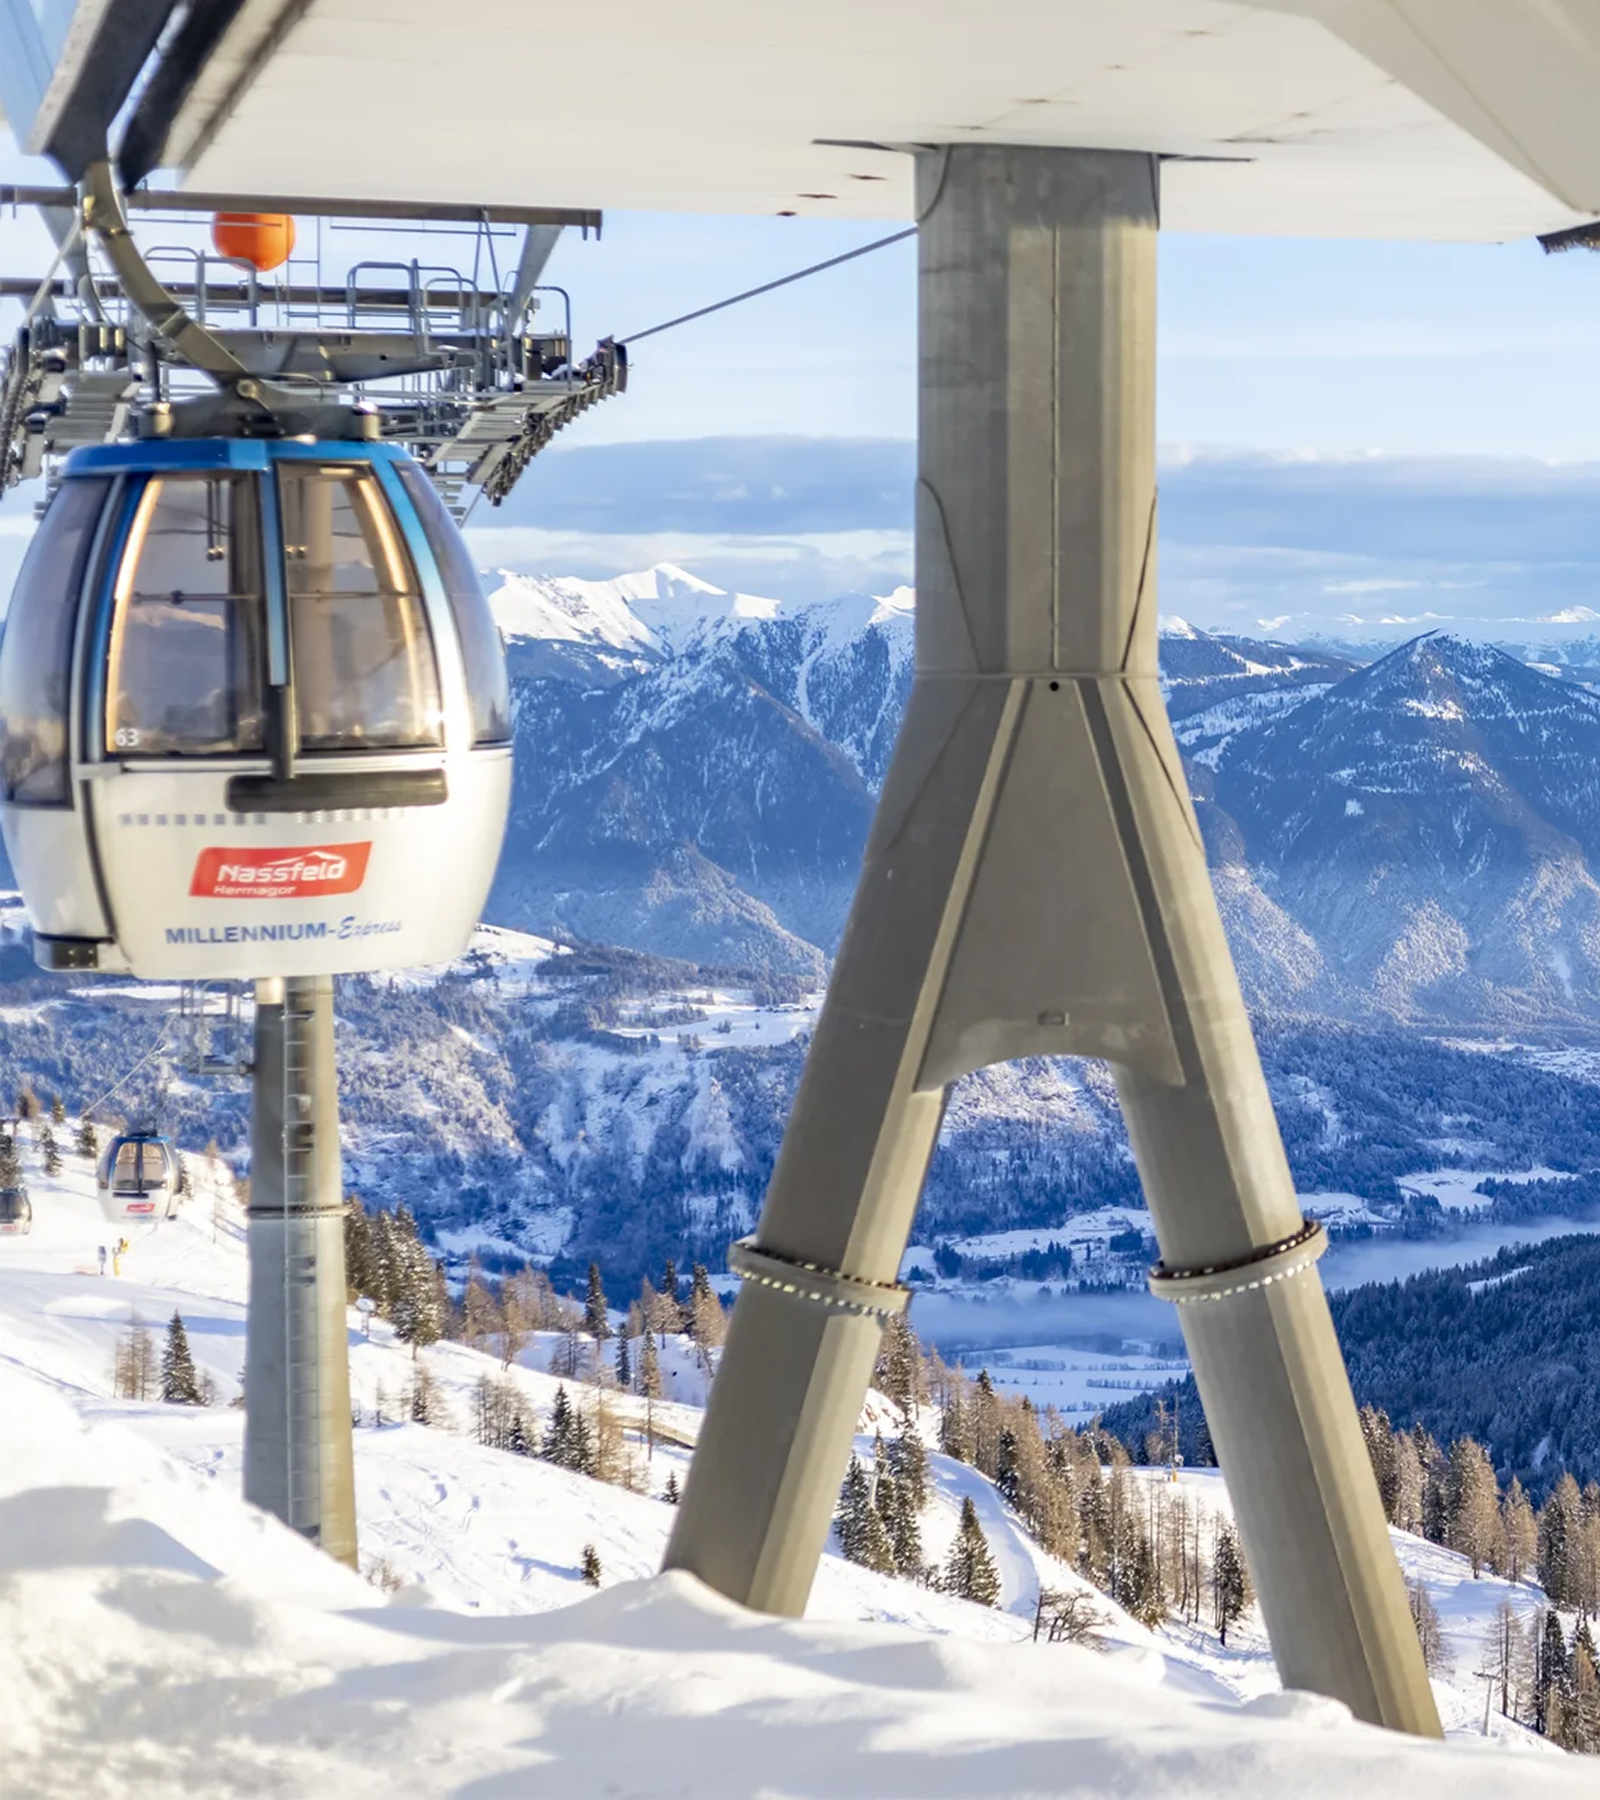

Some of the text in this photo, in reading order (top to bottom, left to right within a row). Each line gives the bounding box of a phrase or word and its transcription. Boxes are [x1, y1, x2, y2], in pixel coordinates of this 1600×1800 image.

[115, 728, 139, 746] 63
[217, 860, 346, 882] Nassfeld
[213, 884, 296, 897] Hermagor
[165, 916, 402, 944] MILLENNIUM-Express
